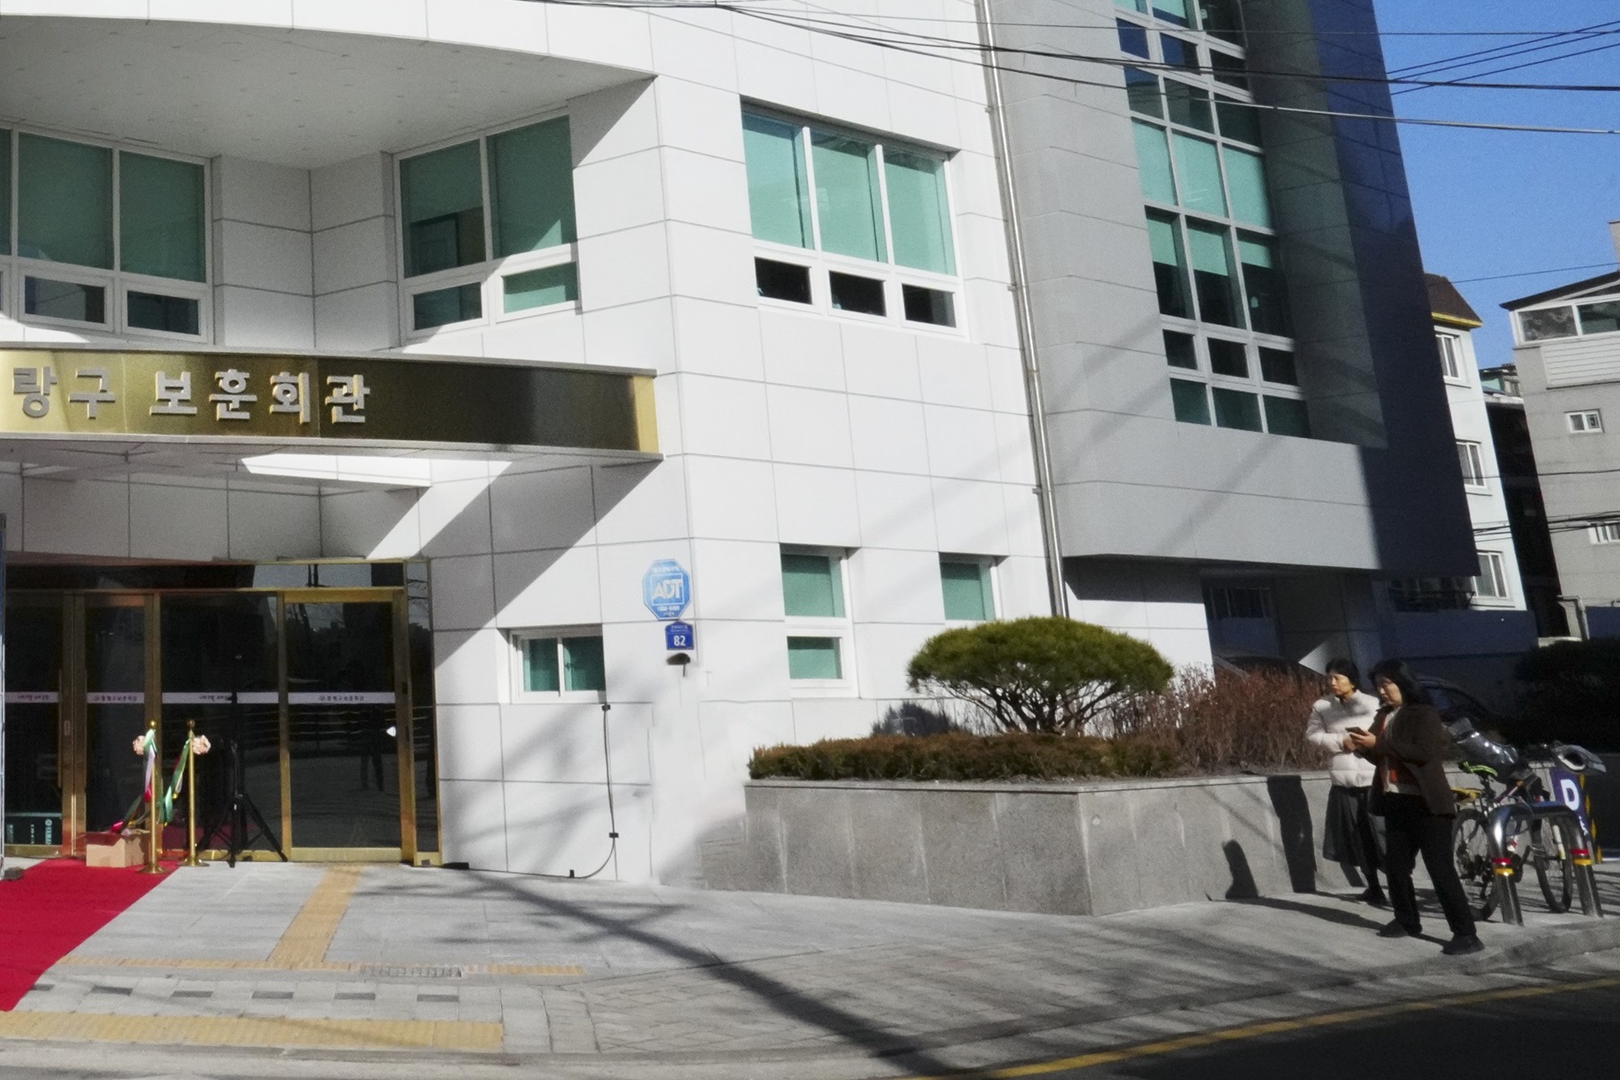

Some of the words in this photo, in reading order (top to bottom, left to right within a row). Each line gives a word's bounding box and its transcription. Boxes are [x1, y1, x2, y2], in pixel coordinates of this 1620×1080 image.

[149, 368, 371, 425] 보훈회관
[652, 579, 684, 600] ADT
[673, 634, 686, 647] 82
